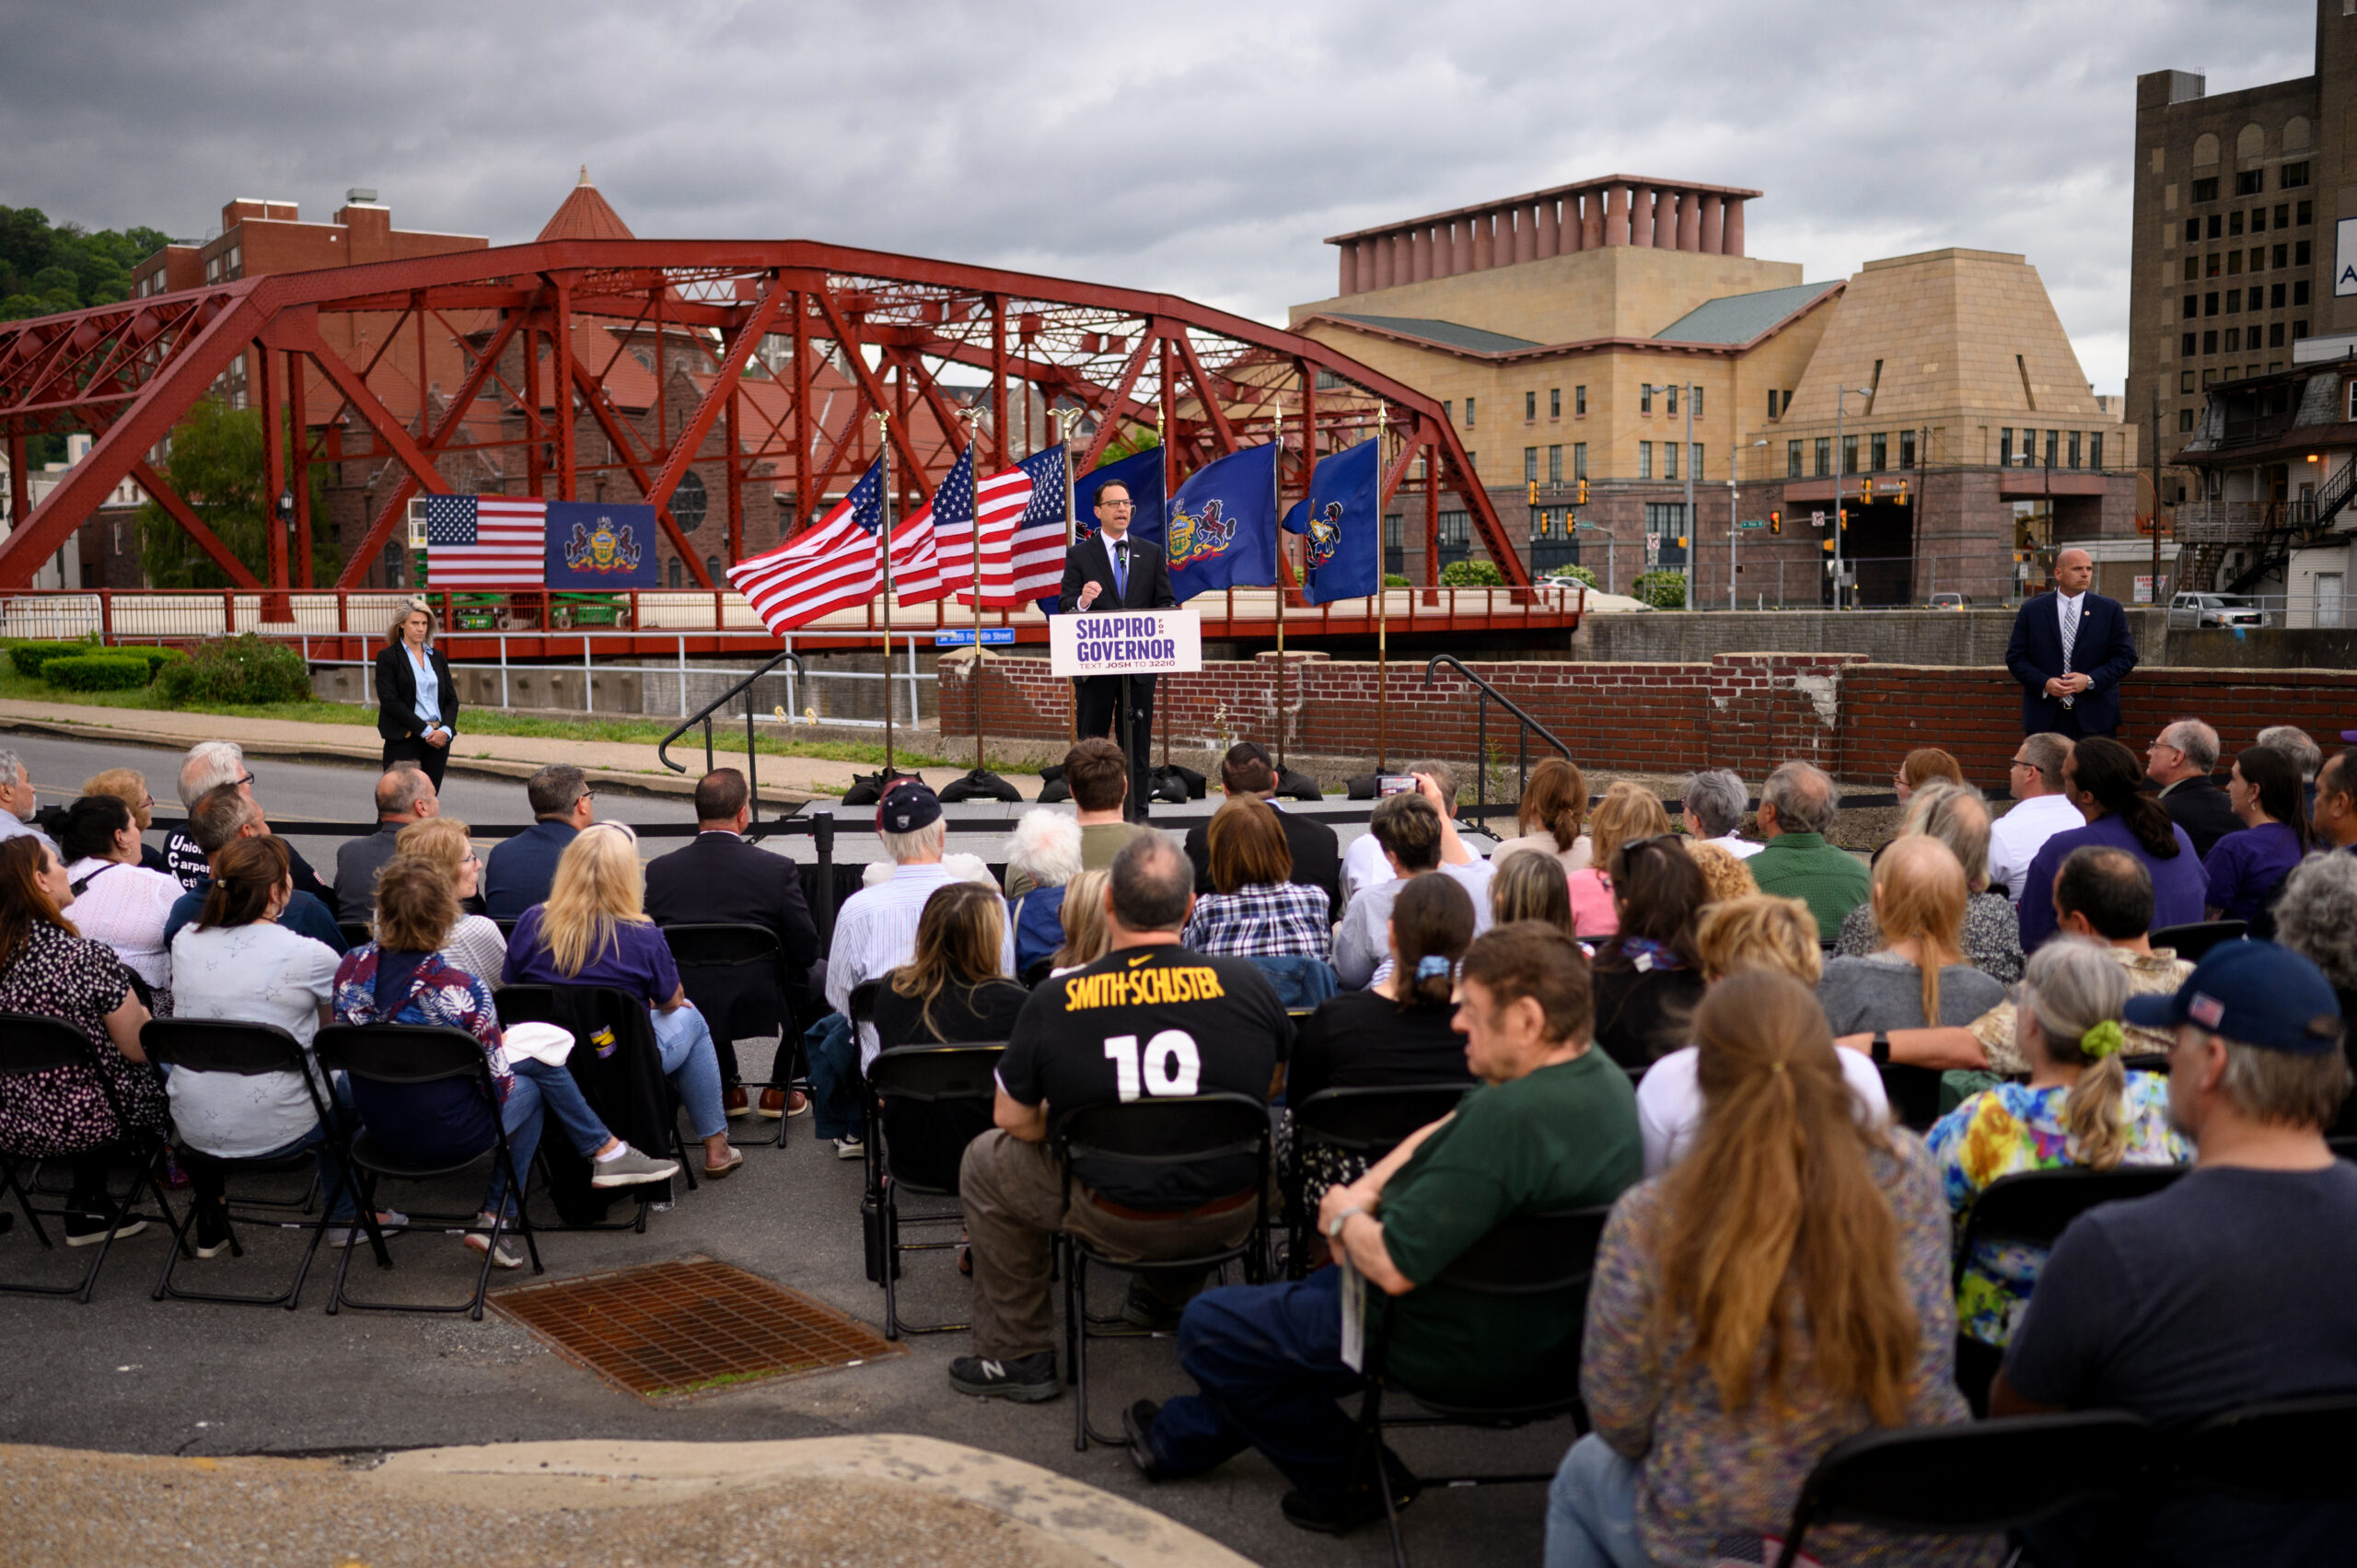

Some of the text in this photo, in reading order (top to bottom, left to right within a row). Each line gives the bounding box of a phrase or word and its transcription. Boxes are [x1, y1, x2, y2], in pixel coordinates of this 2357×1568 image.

[993, 632, 1012, 641] Street
[1076, 617, 1155, 640] SHAPIRO
[1077, 639, 1175, 662] GOVERNOR
[1065, 966, 1225, 1012] SMITH-SCHUSTER
[1104, 1028, 1201, 1104] 10
[981, 1360, 1006, 1380] N
